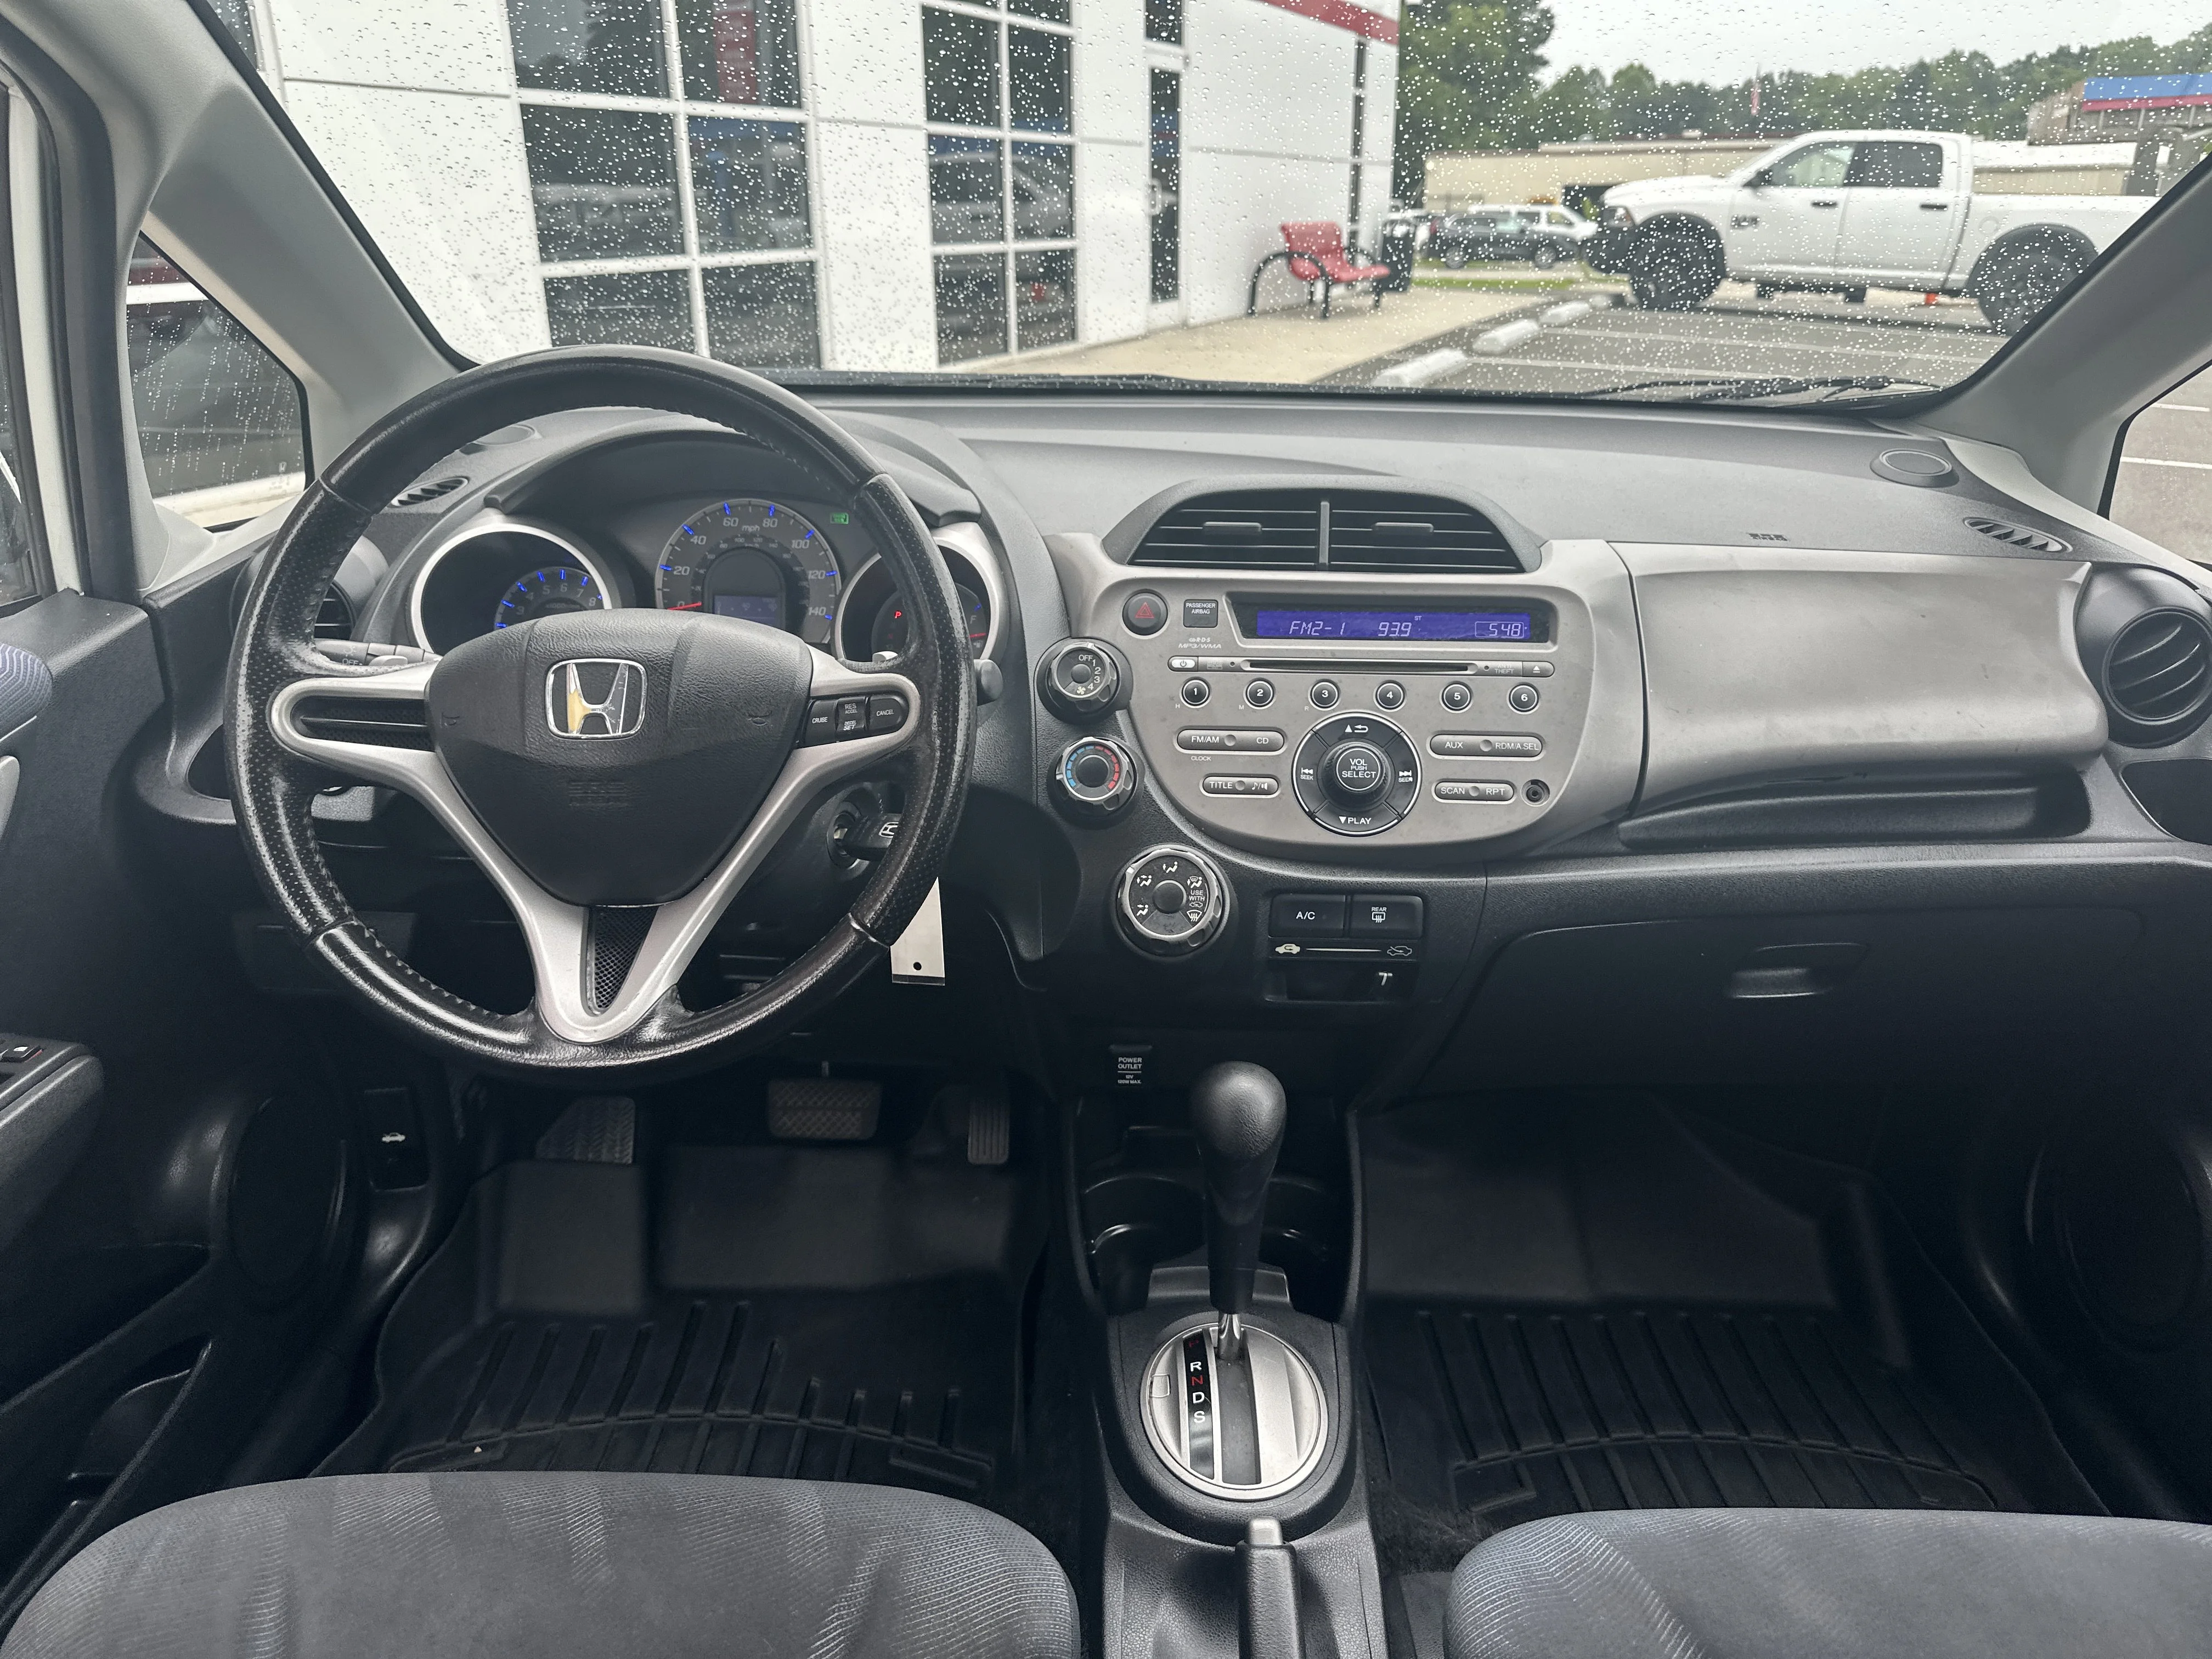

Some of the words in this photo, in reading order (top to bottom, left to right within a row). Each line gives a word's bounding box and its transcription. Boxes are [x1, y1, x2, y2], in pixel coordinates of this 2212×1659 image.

[723, 518, 738, 527] 60
[763, 518, 778, 528] 80
[741, 524, 760, 533] mph
[690, 535, 707, 545] 40
[791, 539, 810, 549] 100
[673, 566, 690, 575] 20
[808, 570, 825, 580] 120
[543, 585, 550, 595] 5
[560, 583, 568, 592] 6
[576, 589, 584, 598] 7
[589, 597, 596, 606] 8
[808, 606, 826, 616] 140
[895, 611, 902, 619] P
[970, 615, 977, 624] F
[1193, 687, 1198, 696] 1
[1322, 690, 1329, 698] 3
[1386, 691, 1393, 699] 4
[1521, 693, 1528, 702] 6
[1296, 912, 1316, 920] A/C
[1190, 1361, 1201, 1372] R
[1191, 1375, 1203, 1386] N
[1192, 1392, 1205, 1404] D
[1193, 1410, 1206, 1424] S
